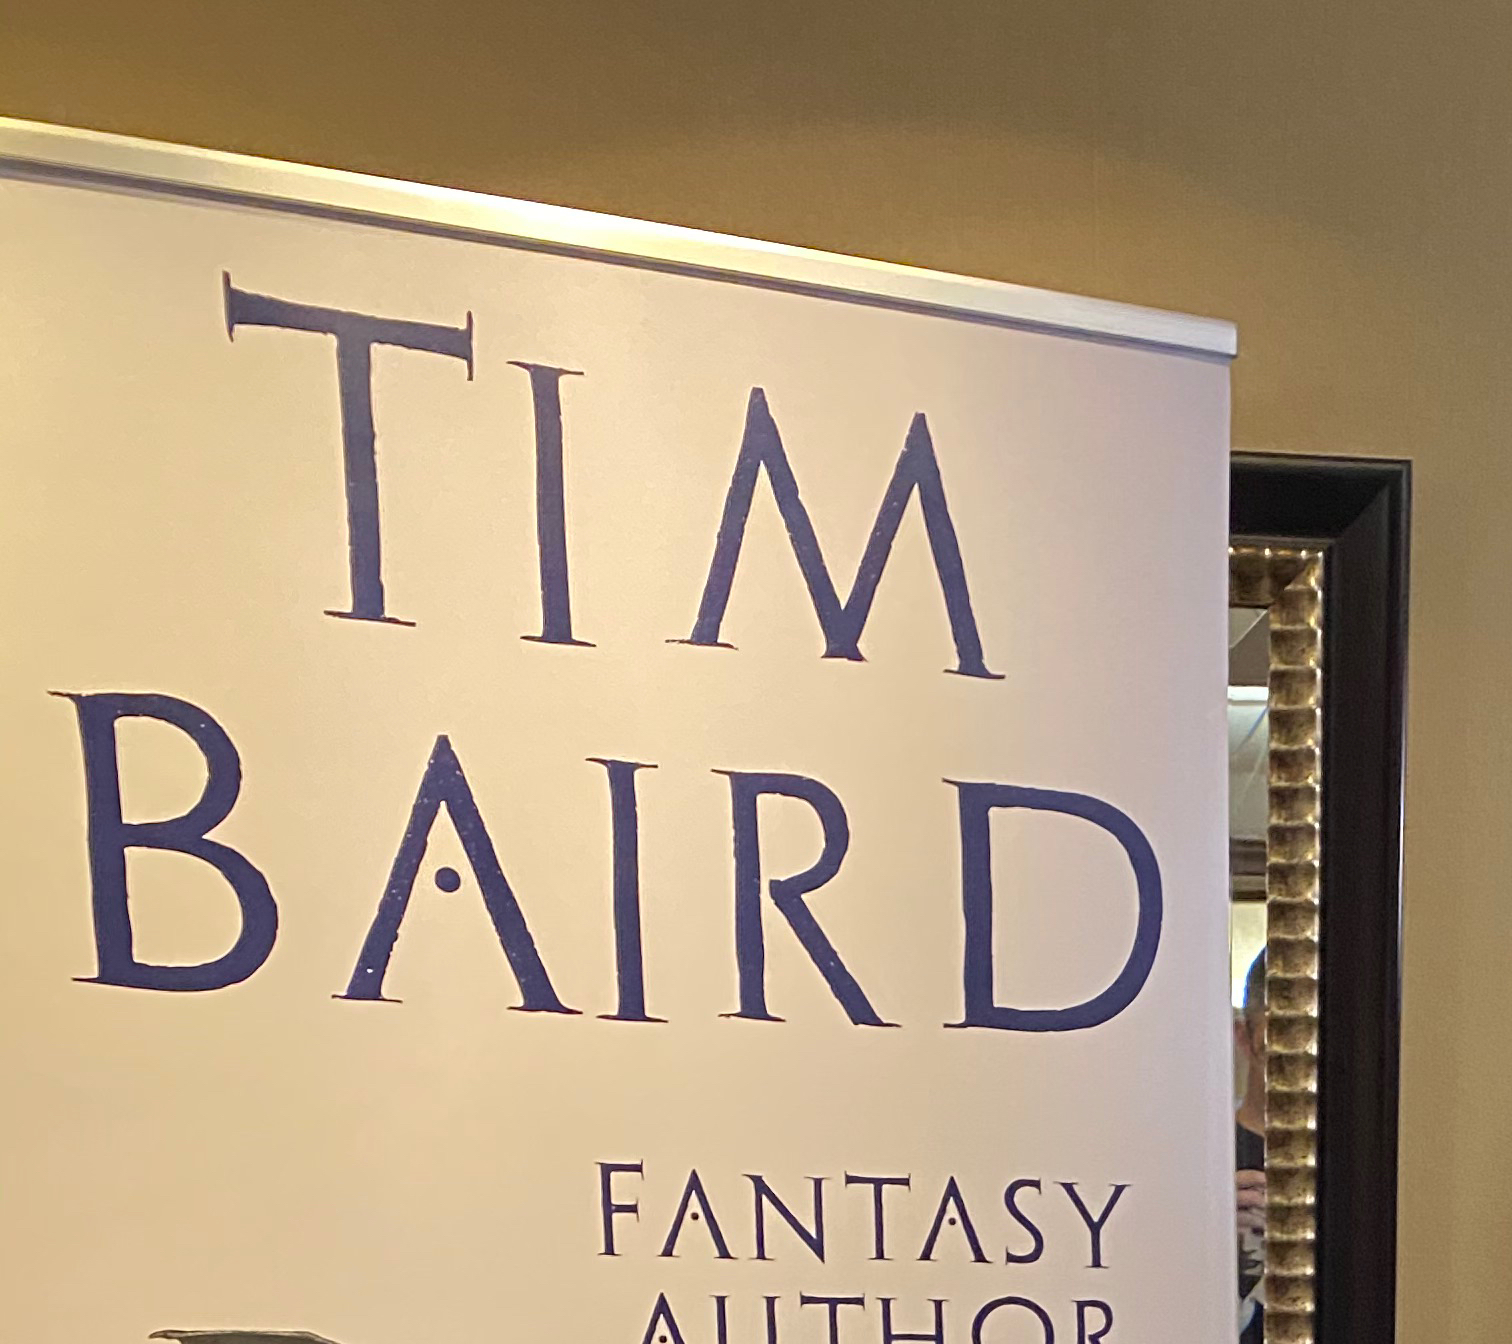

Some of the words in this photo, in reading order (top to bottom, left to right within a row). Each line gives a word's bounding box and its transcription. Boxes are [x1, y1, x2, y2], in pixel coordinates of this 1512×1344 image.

[222, 268, 1006, 680] TIM
[48, 690, 1163, 1033] BAIRD
[595, 1160, 1131, 1270] FANTASY
